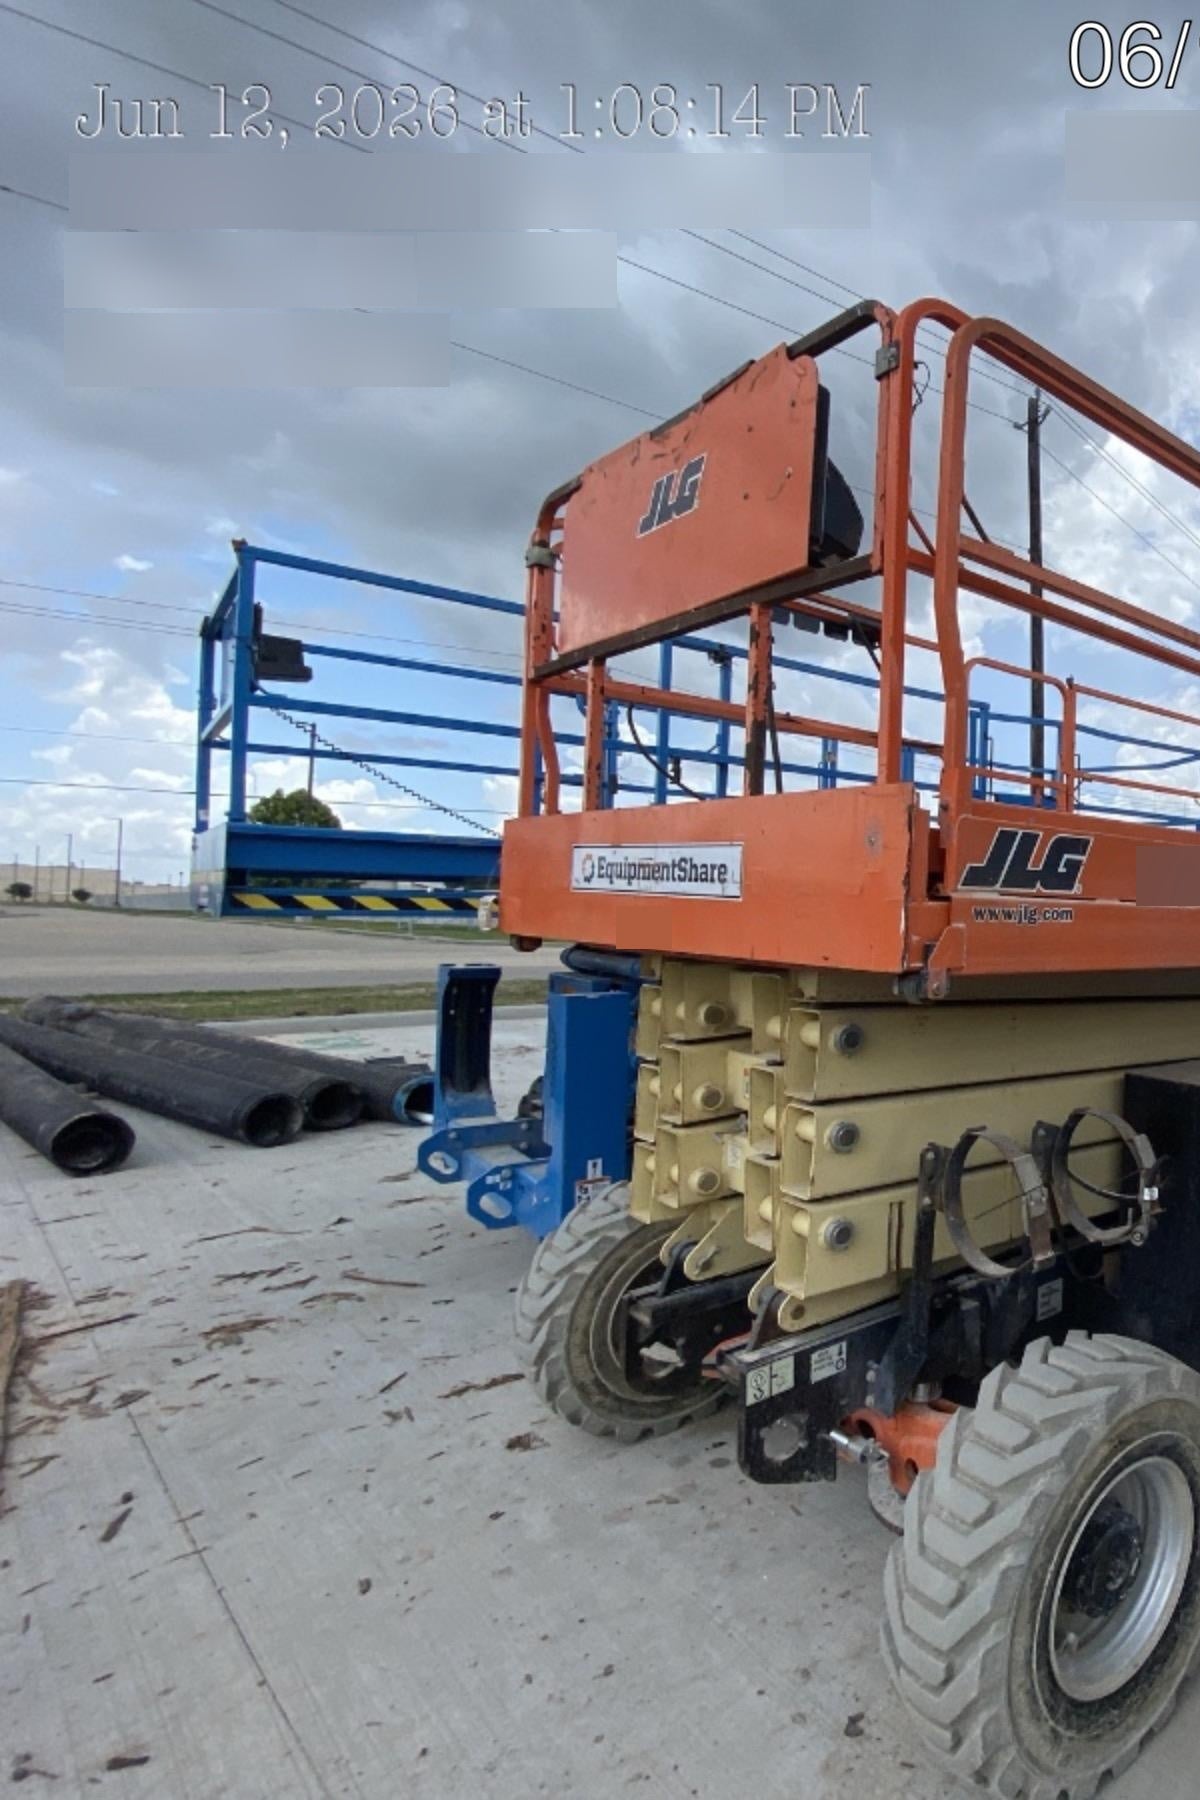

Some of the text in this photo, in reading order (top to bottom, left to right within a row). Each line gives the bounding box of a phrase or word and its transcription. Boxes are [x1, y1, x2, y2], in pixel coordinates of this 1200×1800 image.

[635, 452, 708, 538] JLG
[597, 856, 728, 886] EquipmentShare
[958, 827, 1094, 894] JLG
[973, 904, 1074, 925] www.jlg.com
